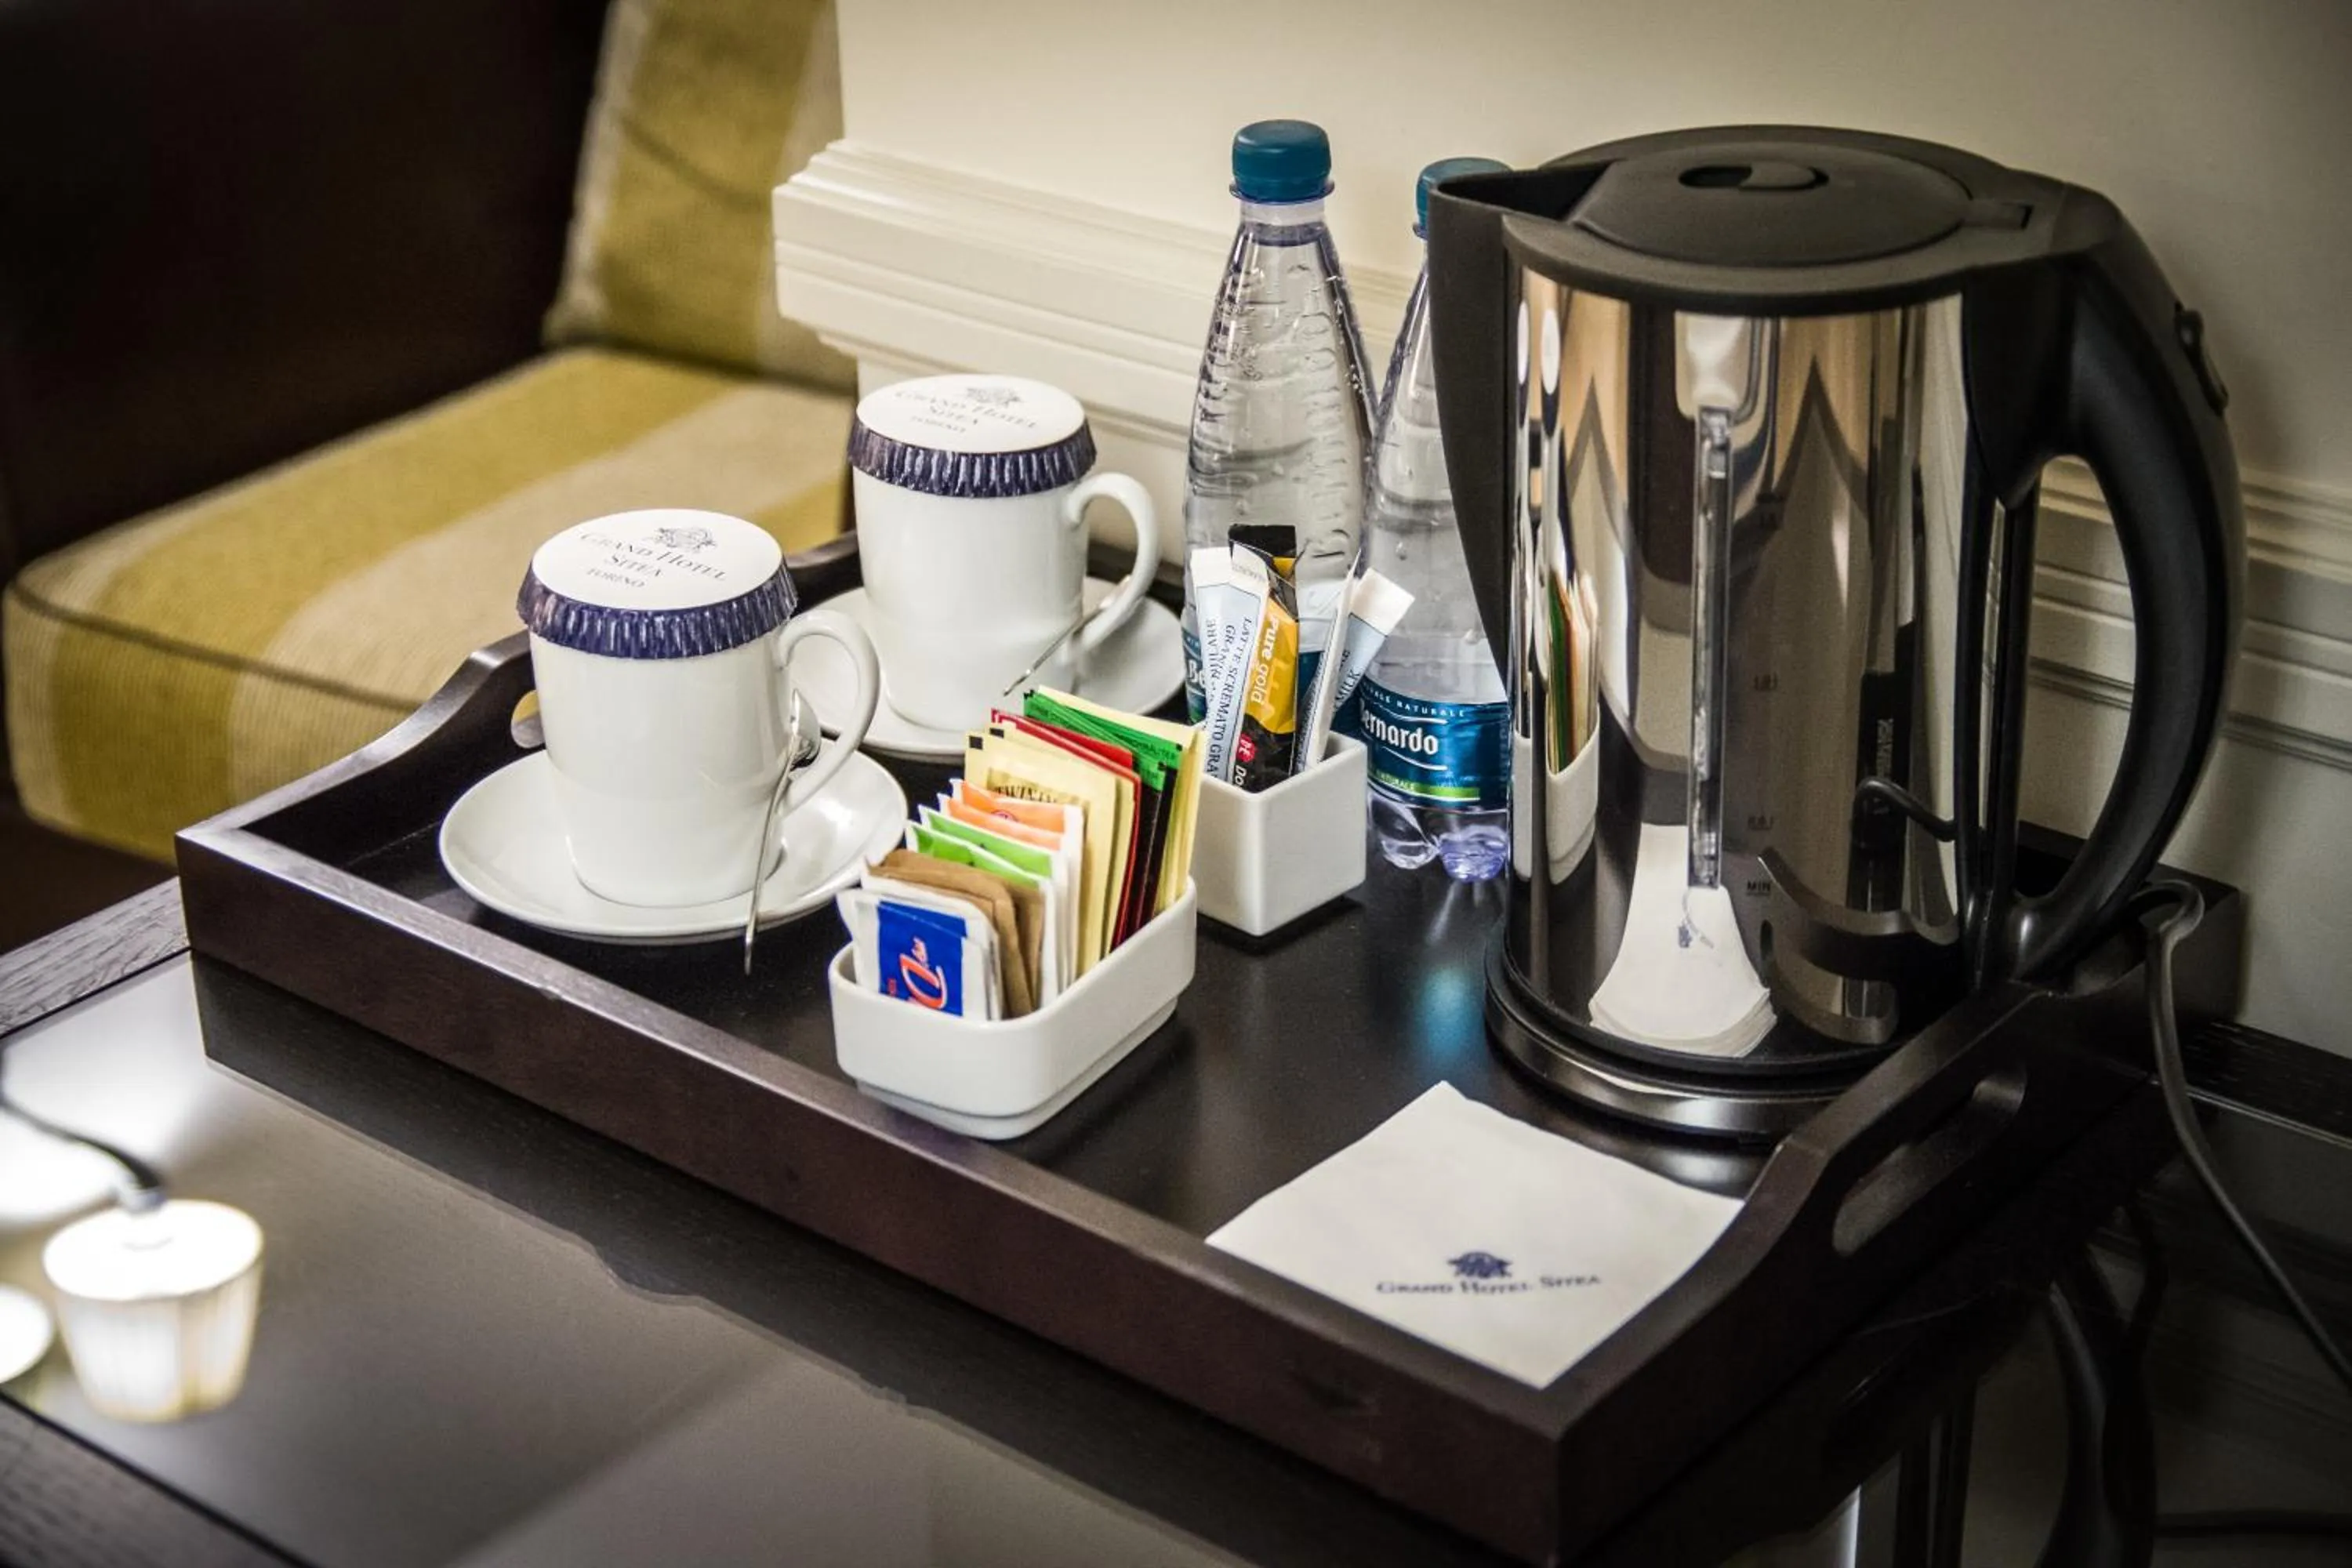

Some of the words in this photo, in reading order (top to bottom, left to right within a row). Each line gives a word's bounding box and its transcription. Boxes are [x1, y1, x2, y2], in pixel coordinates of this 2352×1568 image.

[1212, 666, 1238, 741] SCREMATO
[1396, 699, 1465, 717] NATURALE
[1206, 743, 1222, 779] GRA
